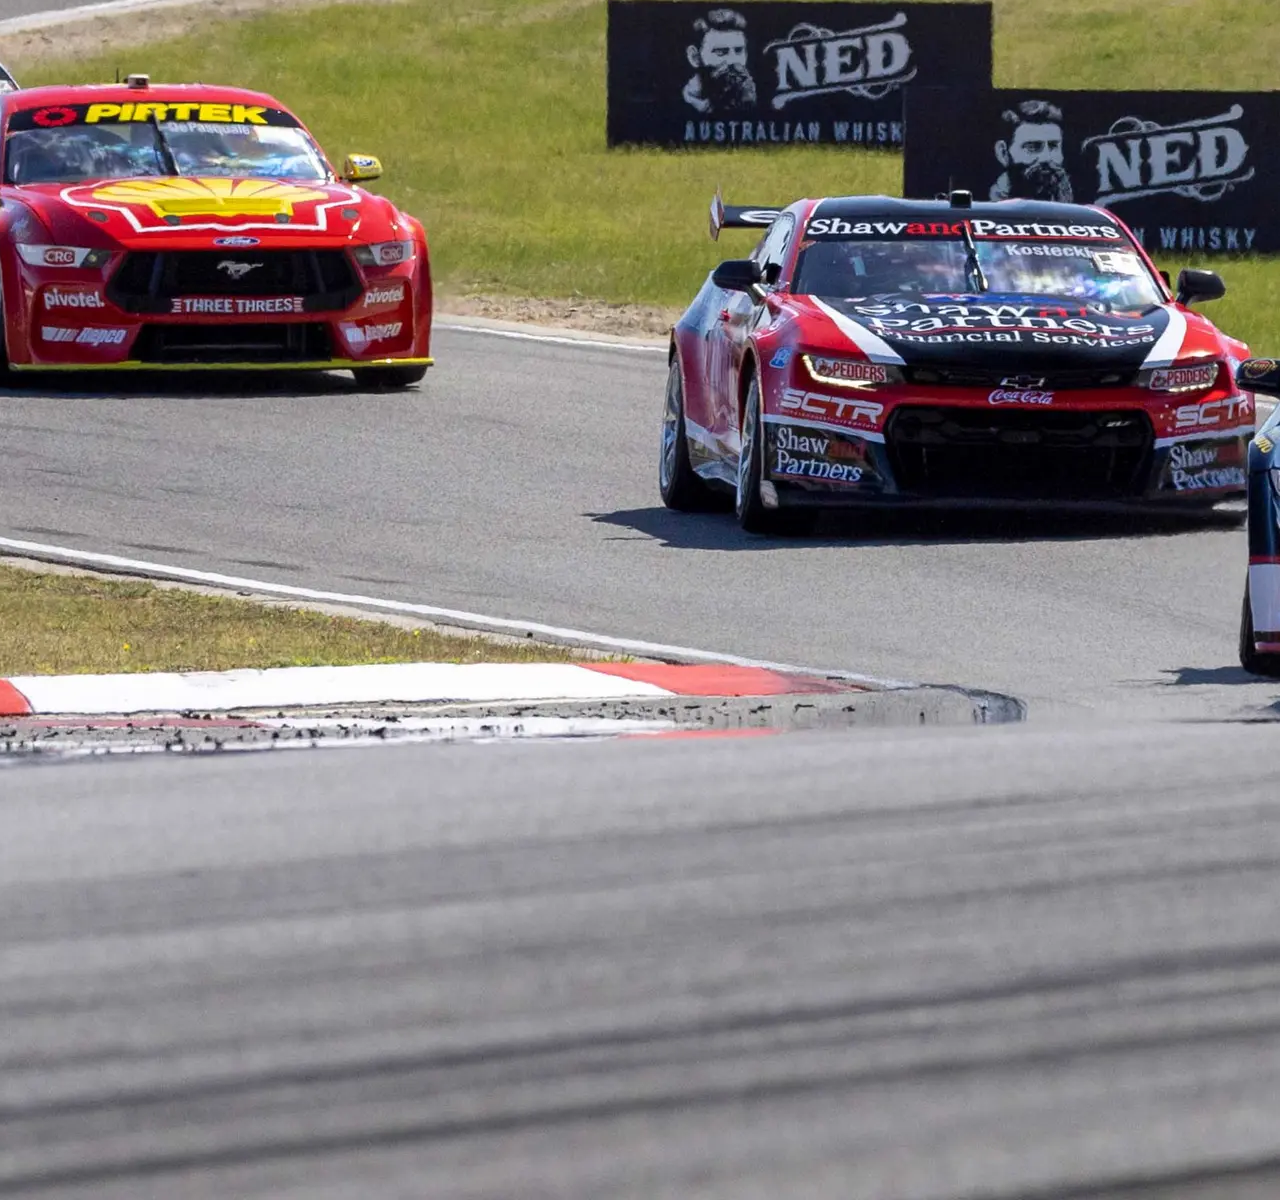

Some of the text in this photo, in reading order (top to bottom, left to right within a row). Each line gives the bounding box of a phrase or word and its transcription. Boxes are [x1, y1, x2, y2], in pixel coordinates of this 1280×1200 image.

[776, 32, 913, 91] NED
[85, 103, 268, 124] PIRTEK
[684, 120, 904, 143] AUSTRALIAN WHISK
[1097, 127, 1249, 193] NED
[1160, 226, 1257, 251] WHISKY
[184, 297, 293, 313] THREE THREES
[869, 313, 1156, 337] Partners
[1033, 331, 1155, 348] Services
[832, 362, 885, 382] PEDDERS
[1167, 366, 1211, 385] PEDDERS
[780, 387, 884, 424] SCTR
[777, 427, 829, 455] Shaw
[776, 449, 863, 482] Partners
